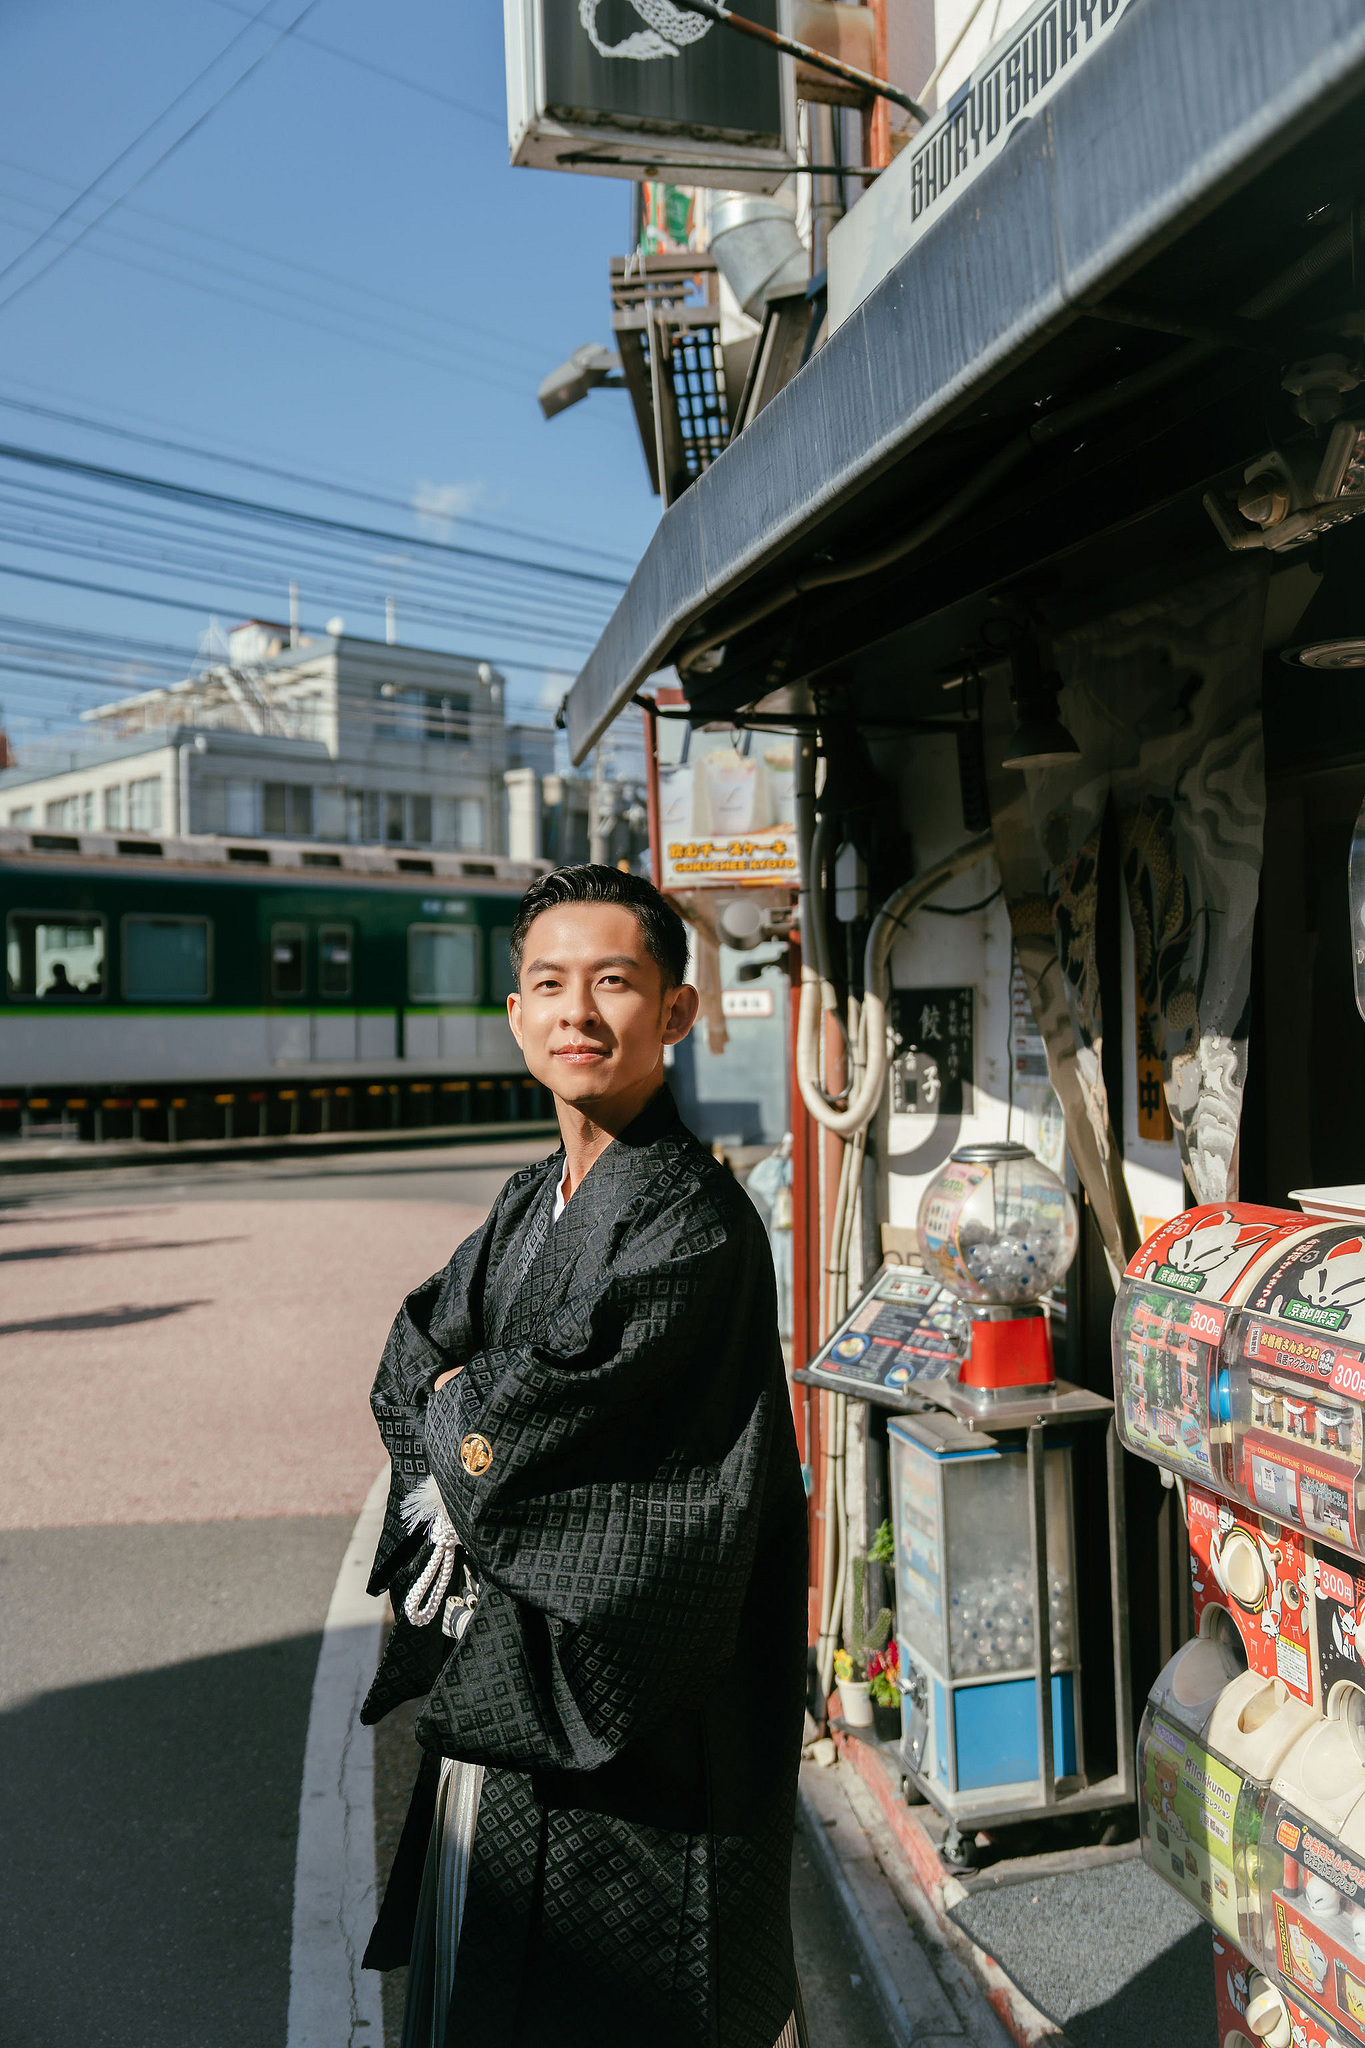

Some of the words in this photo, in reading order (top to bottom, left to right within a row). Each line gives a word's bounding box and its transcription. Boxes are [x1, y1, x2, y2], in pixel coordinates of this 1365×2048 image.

[911, 68, 1001, 223] SHORYU
[750, 859, 796, 871] KYOTO
[920, 1004, 942, 1104] 餃子
[1158, 1269, 1199, 1290] 京都限定
[1190, 1311, 1221, 1337] 300円
[1288, 1303, 1341, 1327] 京都限定
[1189, 1496, 1216, 1522] 300円
[1323, 1570, 1352, 1601] 300円
[1183, 1754, 1232, 1804] Rilakkuma
